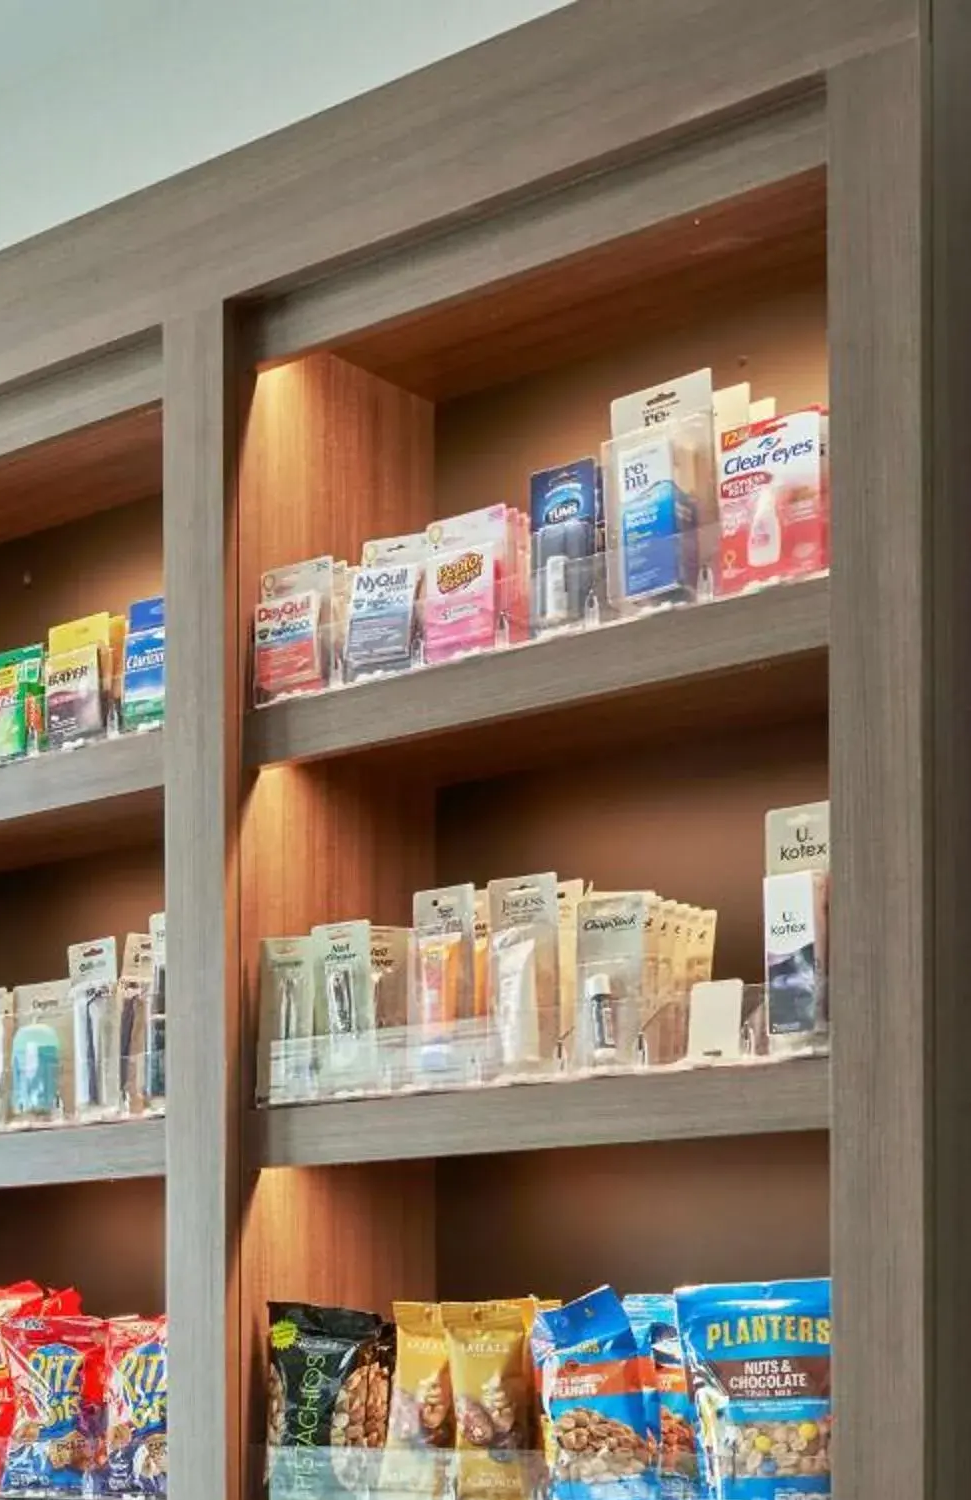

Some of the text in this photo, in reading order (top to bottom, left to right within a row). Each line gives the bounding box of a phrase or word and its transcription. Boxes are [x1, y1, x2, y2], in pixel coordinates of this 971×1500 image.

[724, 438, 814, 475] Clear eyes
[780, 841, 826, 861] kotex
[707, 1315, 830, 1350] PLANTERS
[744, 1359, 792, 1375] NUTS &
[729, 1373, 807, 1389] CHOCOLATE
